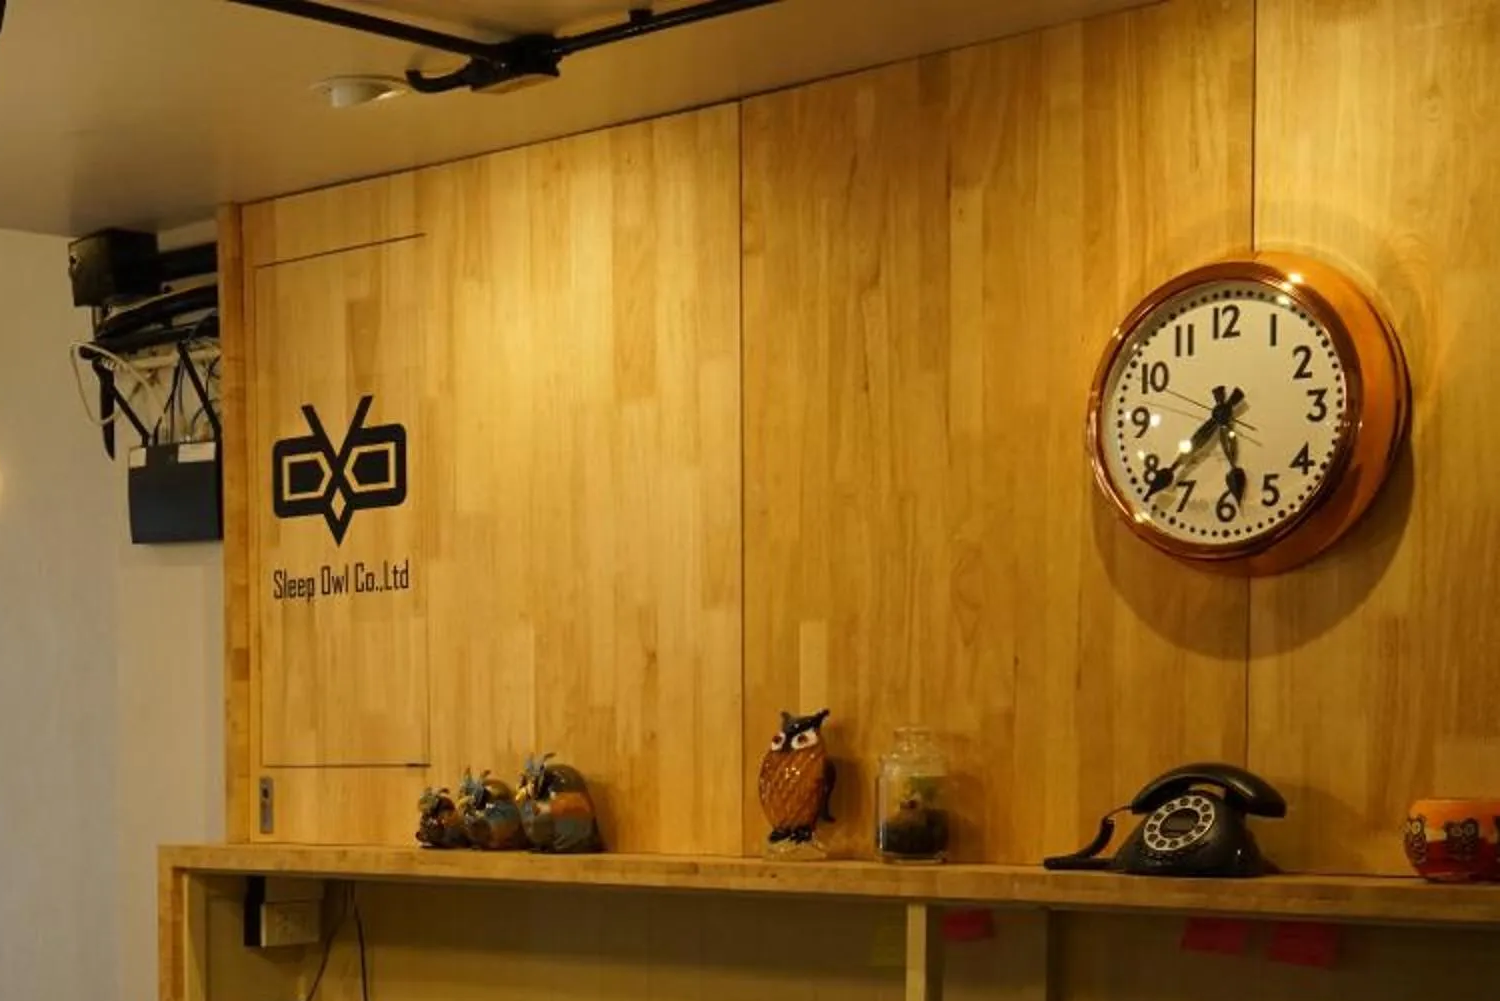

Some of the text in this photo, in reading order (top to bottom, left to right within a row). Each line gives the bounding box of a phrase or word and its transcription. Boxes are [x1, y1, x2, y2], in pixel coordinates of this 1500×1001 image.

[1213, 304, 1241, 340] 12
[1269, 313, 1278, 347] 1
[1175, 323, 1195, 357] 11
[1141, 361, 1170, 395] 10
[1292, 345, 1313, 380] 2
[1130, 406, 1150, 438] 9
[1306, 388, 1328, 422] 3
[1143, 453, 1161, 484] 8
[1289, 442, 1316, 475] 4
[1176, 480, 1197, 513] 7
[1215, 490, 1237, 523] 6
[1261, 473, 1280, 507] 5
[273, 567, 316, 602] Sleep
[321, 563, 349, 595] Owl
